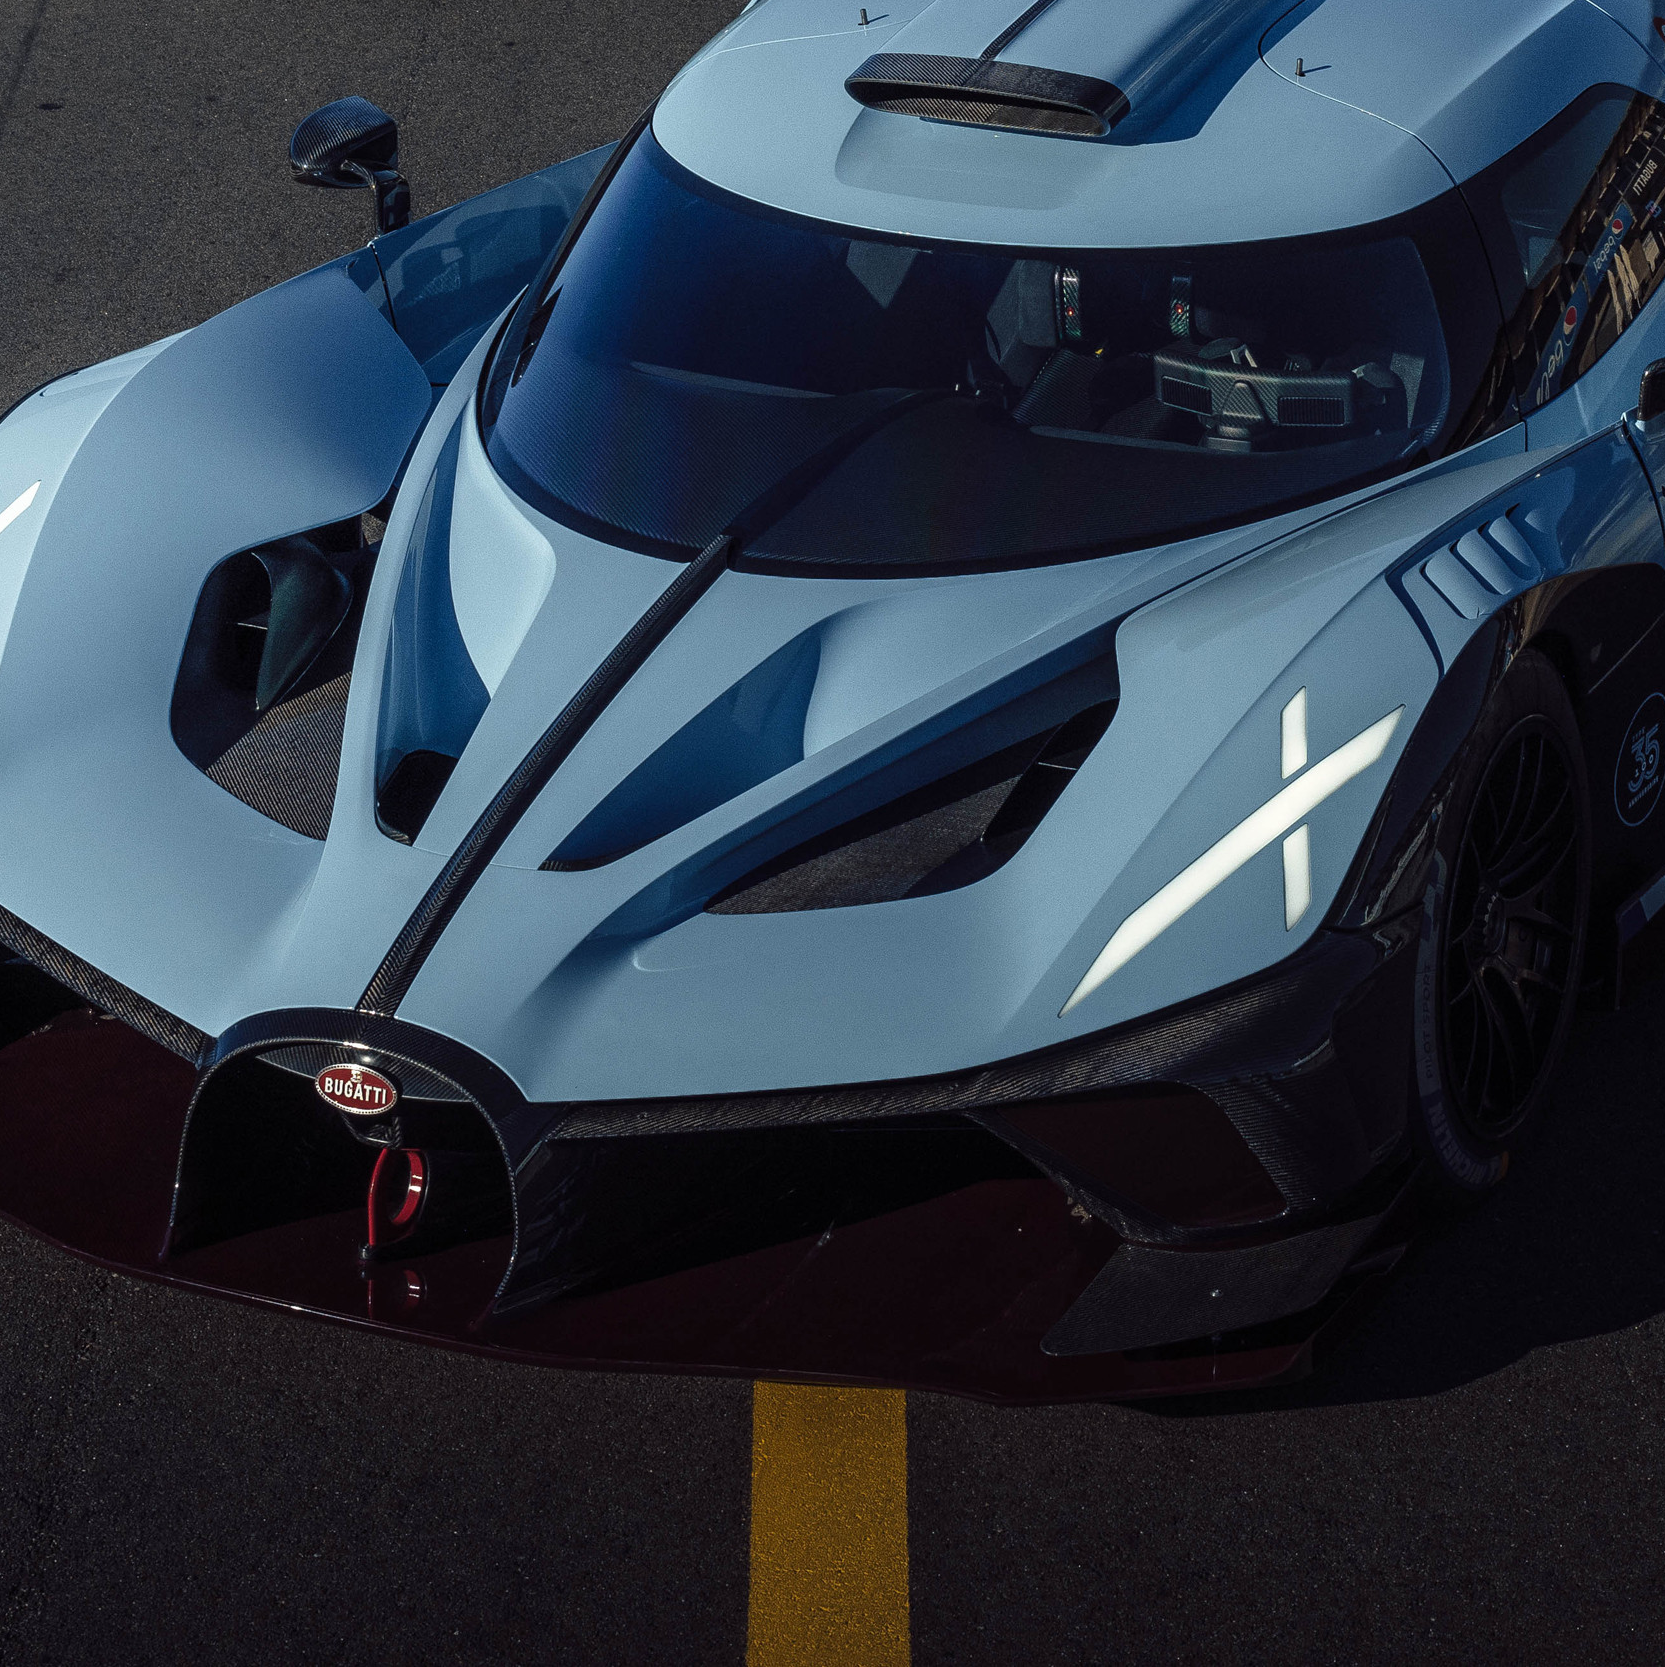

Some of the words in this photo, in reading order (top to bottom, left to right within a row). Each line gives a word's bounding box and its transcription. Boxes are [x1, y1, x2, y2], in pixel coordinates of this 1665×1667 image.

[1421, 961, 1433, 1024] SPORT
[1422, 1031, 1433, 1079] PILOT
[324, 1076, 387, 1105] BUGATTI
